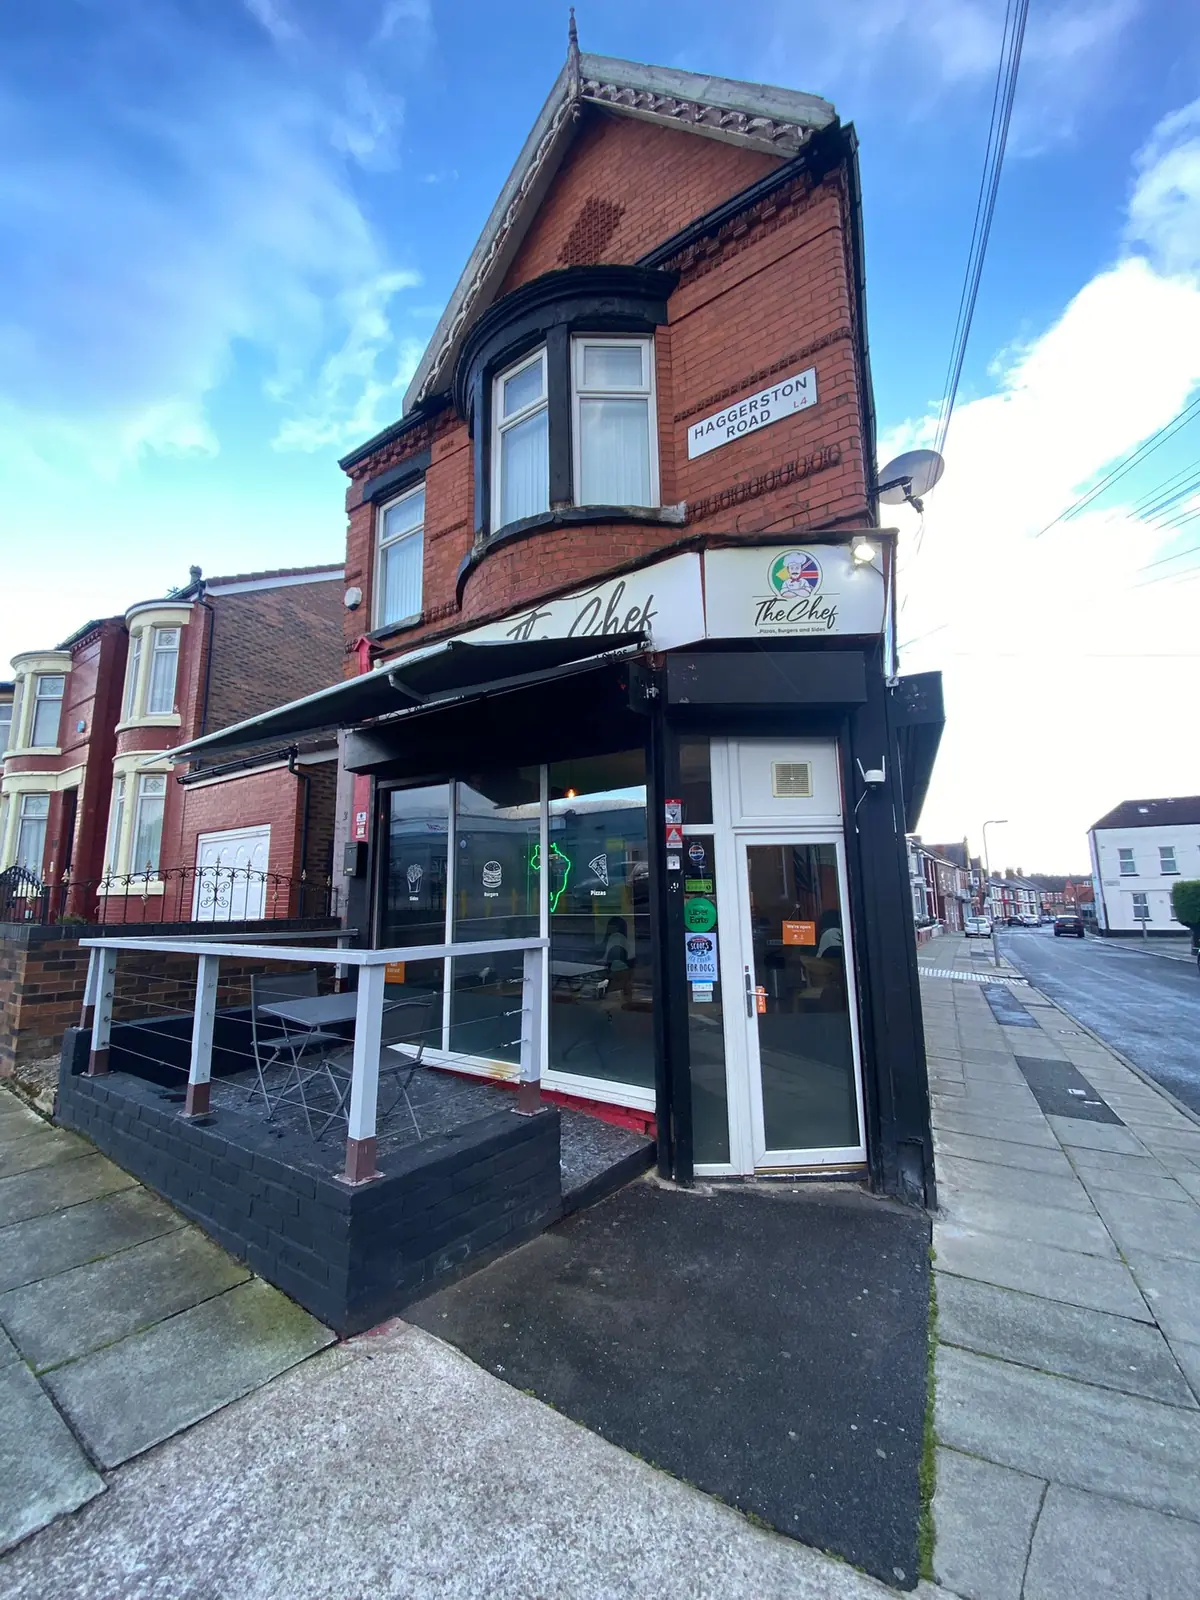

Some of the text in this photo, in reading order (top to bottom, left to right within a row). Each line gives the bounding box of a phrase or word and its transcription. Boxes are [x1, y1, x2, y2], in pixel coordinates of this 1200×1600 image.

[694, 377, 807, 440] HAGGERSTON
[793, 397, 807, 408] L4
[726, 410, 771, 438] ROAD
[754, 595, 839, 629] The Chef
[690, 916, 709, 924] Eats
[687, 963, 715, 972] FOR DOGS
